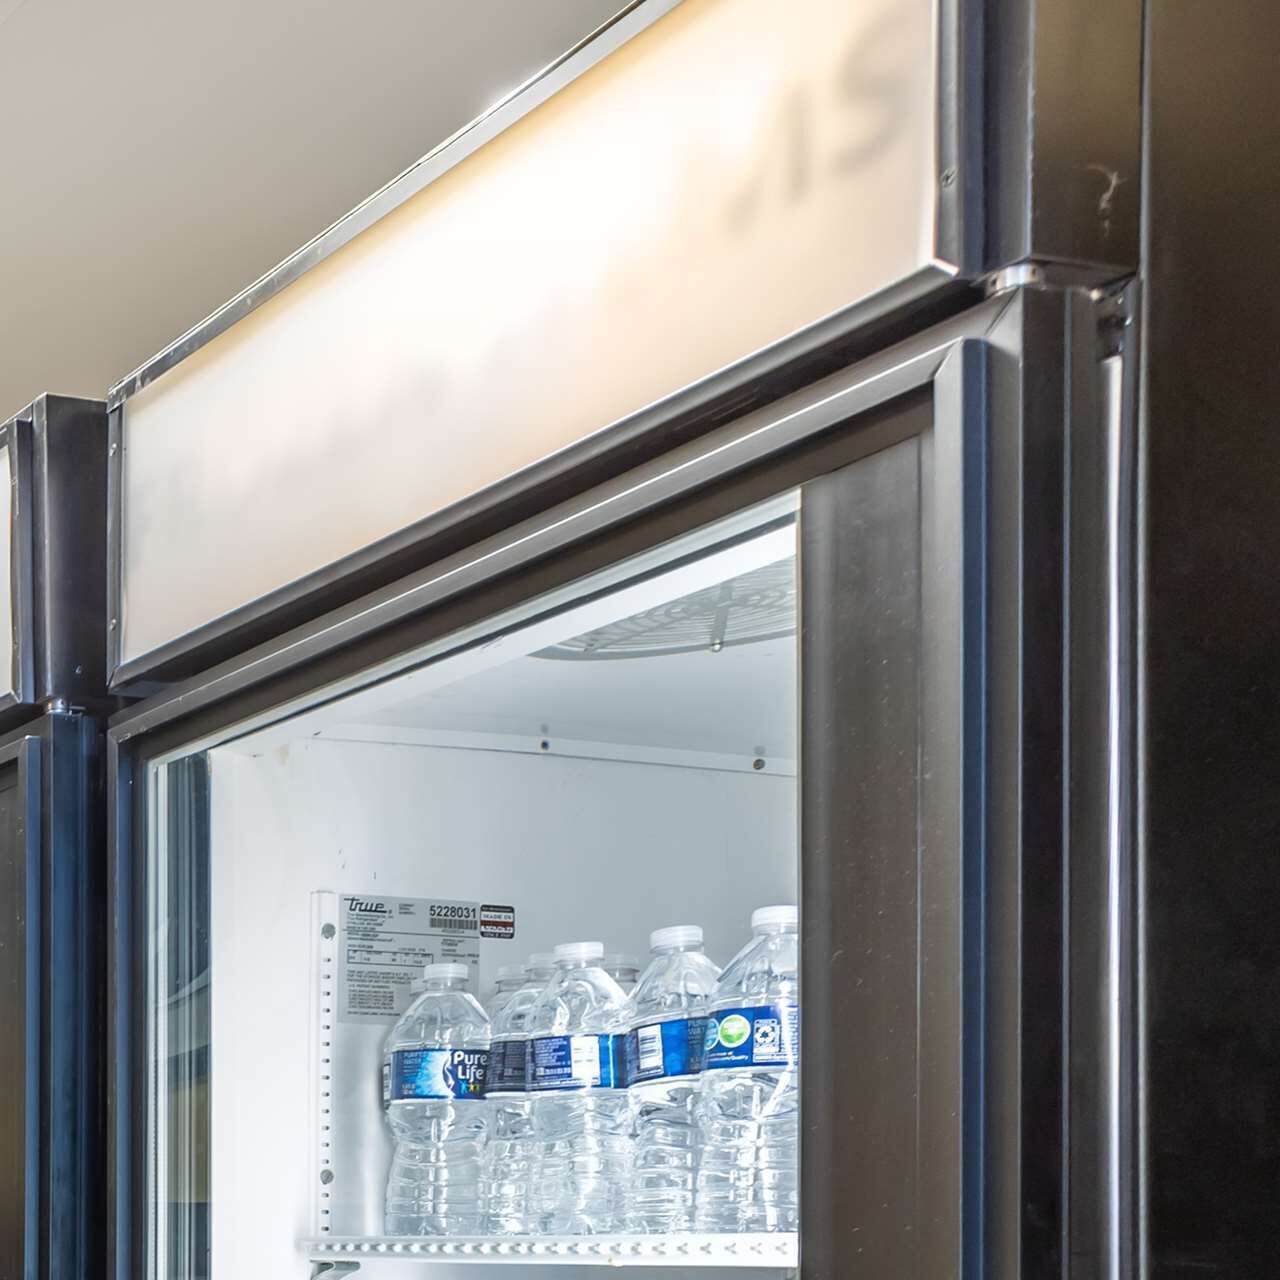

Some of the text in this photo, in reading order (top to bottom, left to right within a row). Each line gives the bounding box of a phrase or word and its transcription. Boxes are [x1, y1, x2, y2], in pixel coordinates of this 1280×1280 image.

[429, 905, 476, 919] 5228031
[453, 1050, 488, 1066] Pure
[457, 1065, 484, 1081] Life
